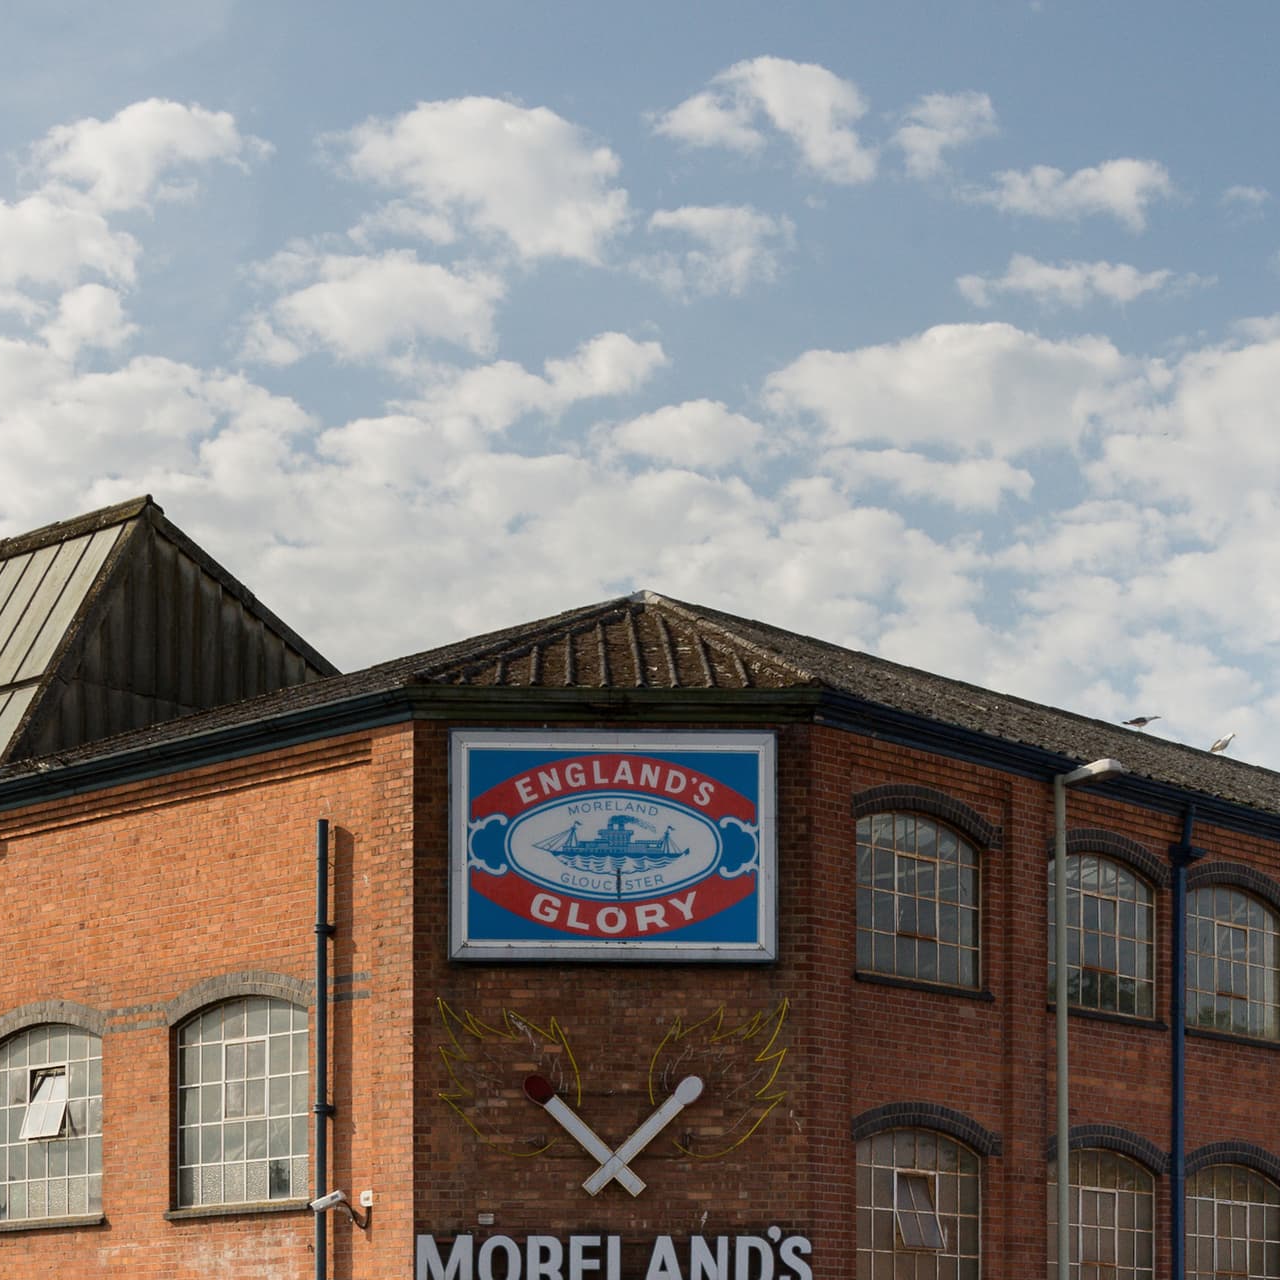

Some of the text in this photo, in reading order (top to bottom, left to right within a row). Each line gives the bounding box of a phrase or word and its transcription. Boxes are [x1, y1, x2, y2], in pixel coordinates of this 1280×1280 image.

[514, 760, 715, 807] ENGLAND'S
[568, 800, 659, 816] MORELAND
[560, 872, 665, 892] GLOUCESTER
[530, 891, 697, 935] GLORY
